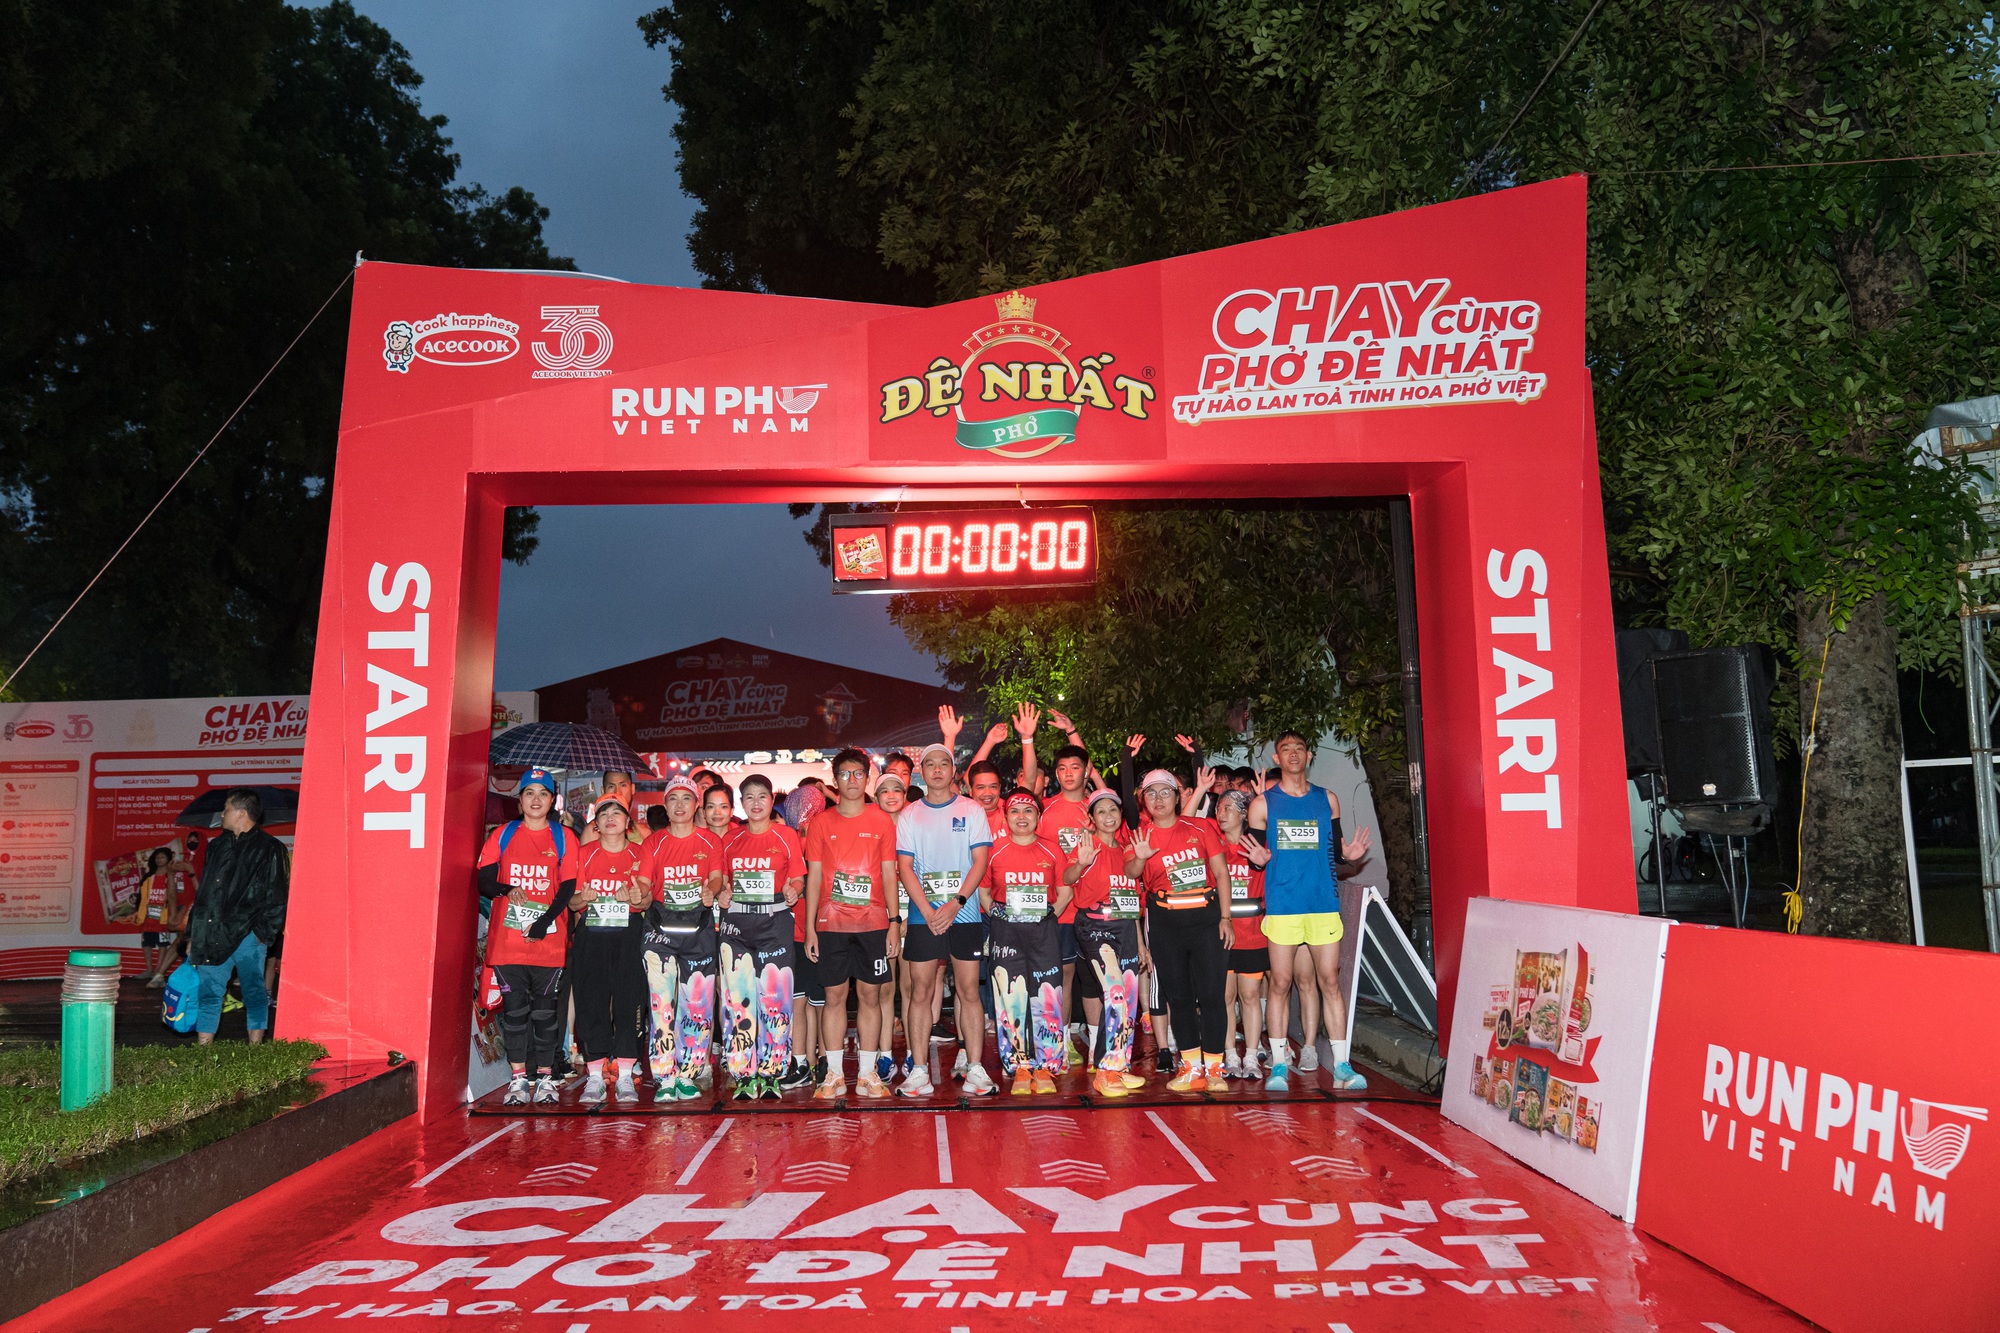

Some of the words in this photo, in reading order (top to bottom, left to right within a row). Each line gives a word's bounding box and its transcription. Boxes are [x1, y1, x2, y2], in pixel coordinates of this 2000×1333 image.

[414, 316, 448, 334] Cook
[452, 314, 518, 335] happiness
[1216, 282, 1446, 346] CHẠY
[1431, 300, 1535, 336] CÙNG
[532, 306, 613, 369] 30
[1201, 343, 1307, 391] PHỞ
[1317, 341, 1385, 386] ĐỆ
[1395, 330, 1531, 379] NHẤT
[880, 355, 964, 424] ĐỆ
[977, 352, 1157, 420] NHẤT
[1177, 397, 1206, 419] TỰ
[1208, 393, 1252, 414] HÀO
[1256, 394, 1298, 411] LAN
[1303, 385, 1342, 408] TOẢ
[1349, 387, 1396, 406] TINH
[1399, 383, 1444, 402] HOA
[1448, 376, 1493, 398] PHỞ
[1496, 372, 1542, 397] VIỆT
[611, 387, 705, 417] RUN
[612, 418, 701, 436] VIET
[732, 417, 810, 434] NAM
[992, 415, 1039, 443] PHỞ
[891, 520, 1088, 577] 00:00:00
[667, 677, 754, 704] CHẠY
[747, 683, 787, 698] CÙNG
[1486, 548, 1562, 829] START
[205, 700, 293, 727] CHẠY
[363, 561, 431, 849] START
[662, 702, 702, 722] PHỞ
[705, 701, 730, 720] ĐỆ
[199, 726, 240, 745] PHỞ
[243, 723, 269, 742] ĐỆ
[1290, 828, 1316, 837] 5259
[510, 863, 549, 877] RUN
[663, 864, 698, 878] RUN
[732, 857, 771, 869] RUN
[1161, 847, 1199, 868] RUN
[745, 880, 772, 889] 5302
[1005, 871, 1045, 884] RUN
[1109, 875, 1137, 887] RUN
[1181, 867, 1204, 879] 5308
[675, 889, 700, 899] 5305
[844, 882, 869, 893] 5378
[1120, 897, 1138, 906] 5303
[1702, 1042, 1808, 1133] RUN
[1701, 1109, 1796, 1172] VIET
[1832, 1155, 1946, 1231] NAM
[380, 1184, 1198, 1247] CHẠY
[1169, 1197, 1531, 1231] CÙNG
[255, 1243, 711, 1296] PHỞ
[746, 1241, 1009, 1289] ĐỆ
[1062, 1227, 1546, 1278] NHẤT
[218, 1302, 334, 1325] TỰ
[350, 1297, 519, 1321] HÀO
[531, 1296, 698, 1314] LAN
[716, 1286, 872, 1311] TOẢ
[895, 1289, 1077, 1310] TINH
[1092, 1285, 1253, 1304] HOA
[1271, 1275, 1428, 1299] PHỞ
[1442, 1275, 1599, 1300] VIỆT
